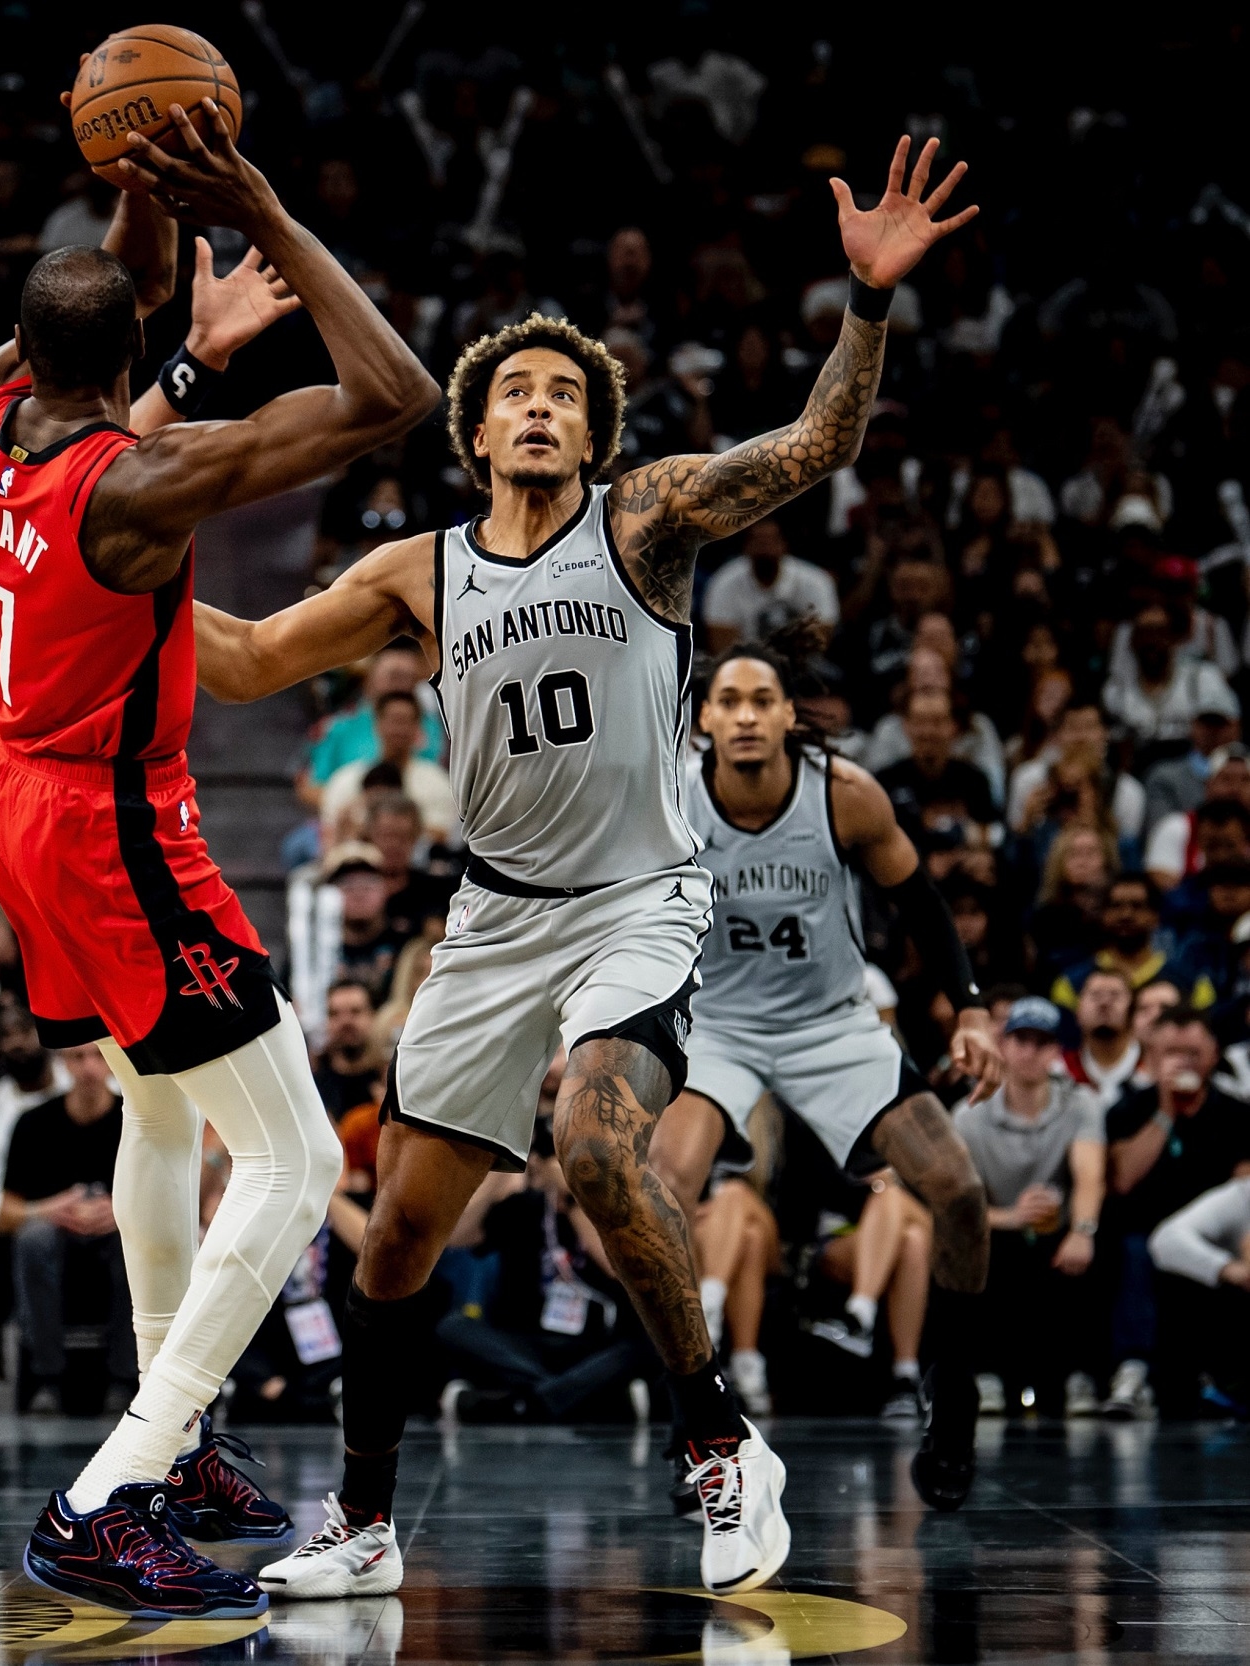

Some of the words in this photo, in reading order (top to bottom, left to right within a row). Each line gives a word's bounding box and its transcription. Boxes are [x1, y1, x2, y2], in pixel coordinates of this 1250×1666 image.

[74, 94, 163, 144] Wilson
[558, 559, 597, 573] LEDGER
[451, 617, 497, 684] SAN
[501, 599, 629, 650] ANTONIO
[497, 668, 596, 758] 10
[736, 863, 831, 899] ANTONIO
[725, 913, 811, 964] 24
